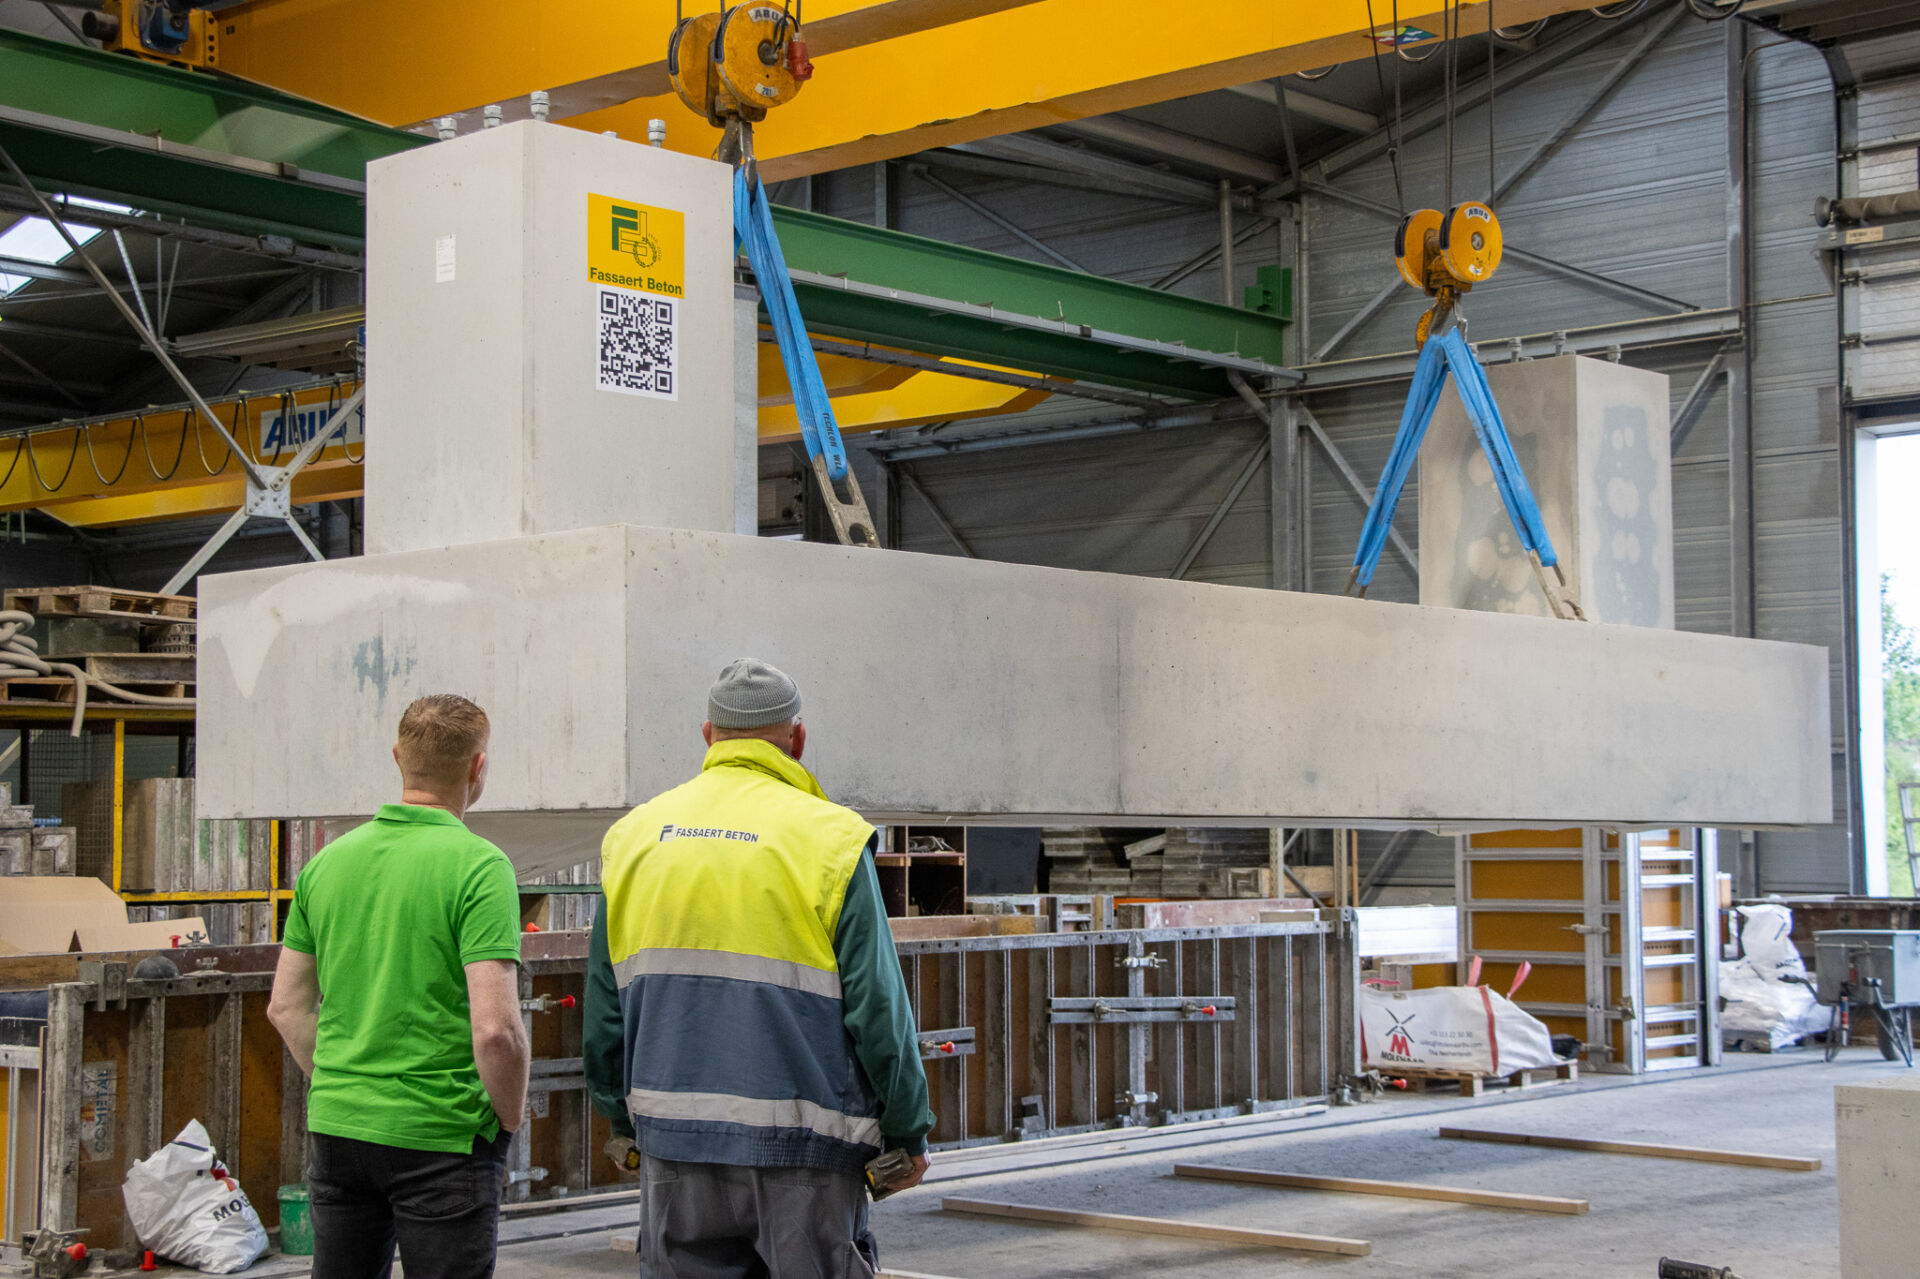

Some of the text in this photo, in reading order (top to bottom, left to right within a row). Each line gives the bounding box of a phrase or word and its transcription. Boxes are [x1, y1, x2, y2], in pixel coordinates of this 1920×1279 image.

[590, 267, 682, 294] Fassaert Beton
[676, 828, 723, 838] FASSAERT
[725, 830, 759, 842] BETON
